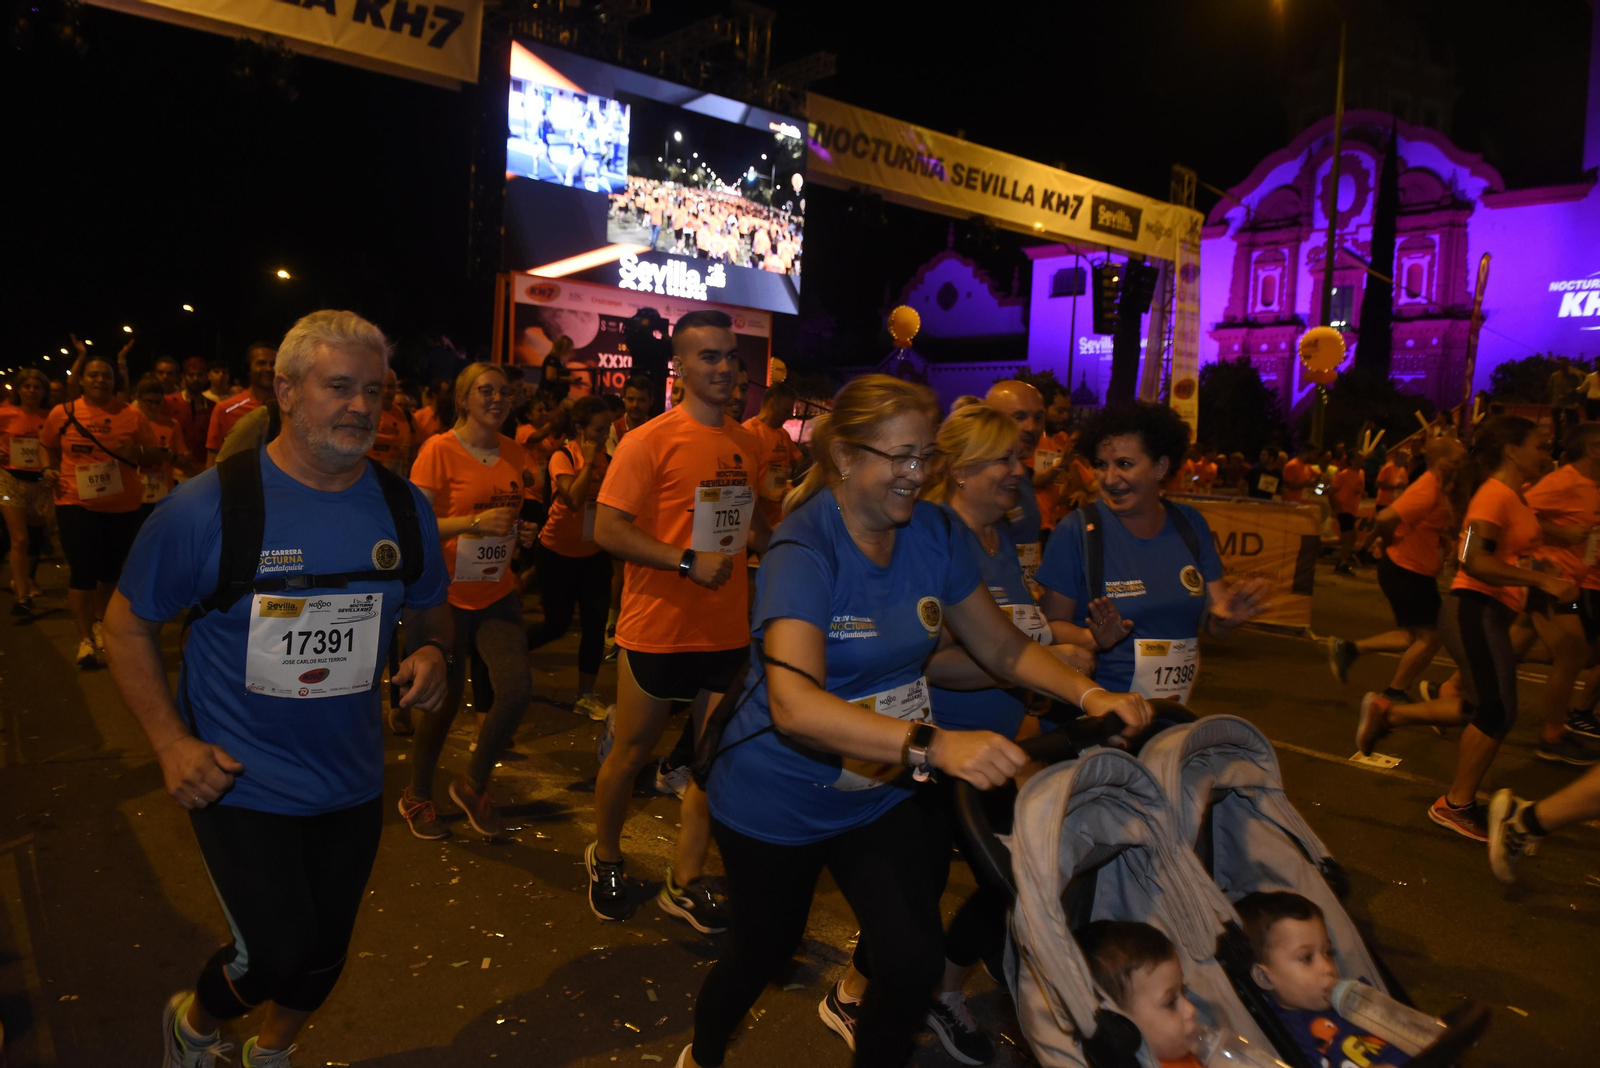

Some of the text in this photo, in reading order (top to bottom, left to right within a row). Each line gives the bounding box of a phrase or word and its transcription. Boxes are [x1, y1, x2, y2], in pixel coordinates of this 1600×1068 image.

[811, 121, 947, 182] NOCTURNA
[950, 162, 1035, 208] SEVILLA
[88, 472, 111, 485] 6789
[715, 509, 741, 528] 7762
[477, 545, 507, 561] 3066
[260, 563, 305, 575] Guadalquivir
[281, 627, 354, 656] 17391
[1154, 663, 1195, 686] 17398
